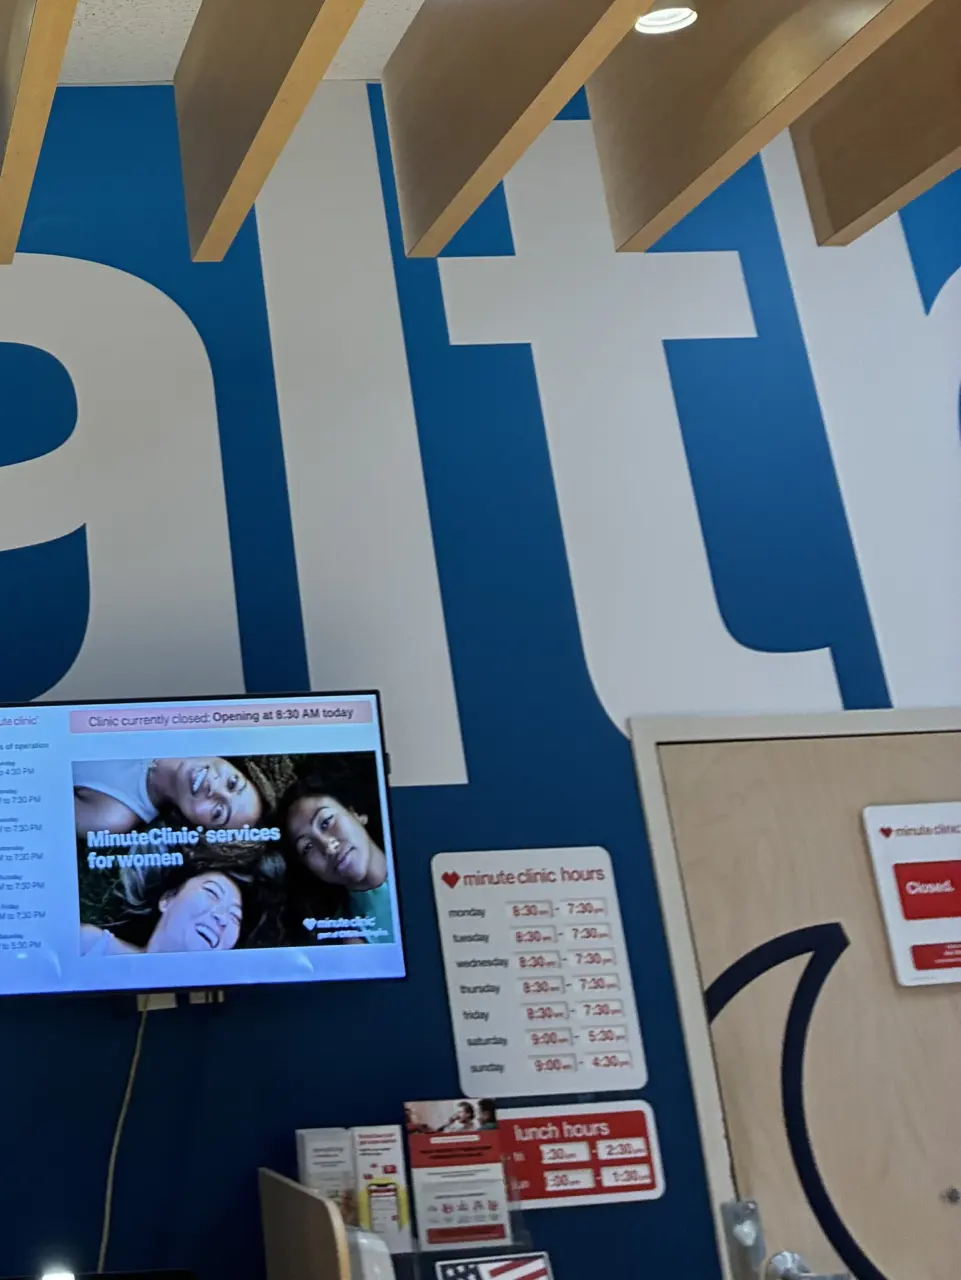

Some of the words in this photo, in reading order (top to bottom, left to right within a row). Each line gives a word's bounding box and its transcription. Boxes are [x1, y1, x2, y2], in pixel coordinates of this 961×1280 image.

[89, 716, 116, 727] Clinic
[121, 713, 169, 726] currently
[171, 712, 210, 724] closed:
[212, 710, 260, 724] Opening
[262, 710, 273, 720] at
[276, 709, 300, 720] 8:30
[302, 708, 320, 718] AM
[322, 706, 354, 720] today
[5, 741, 13, 750] of
[15, 742, 50, 751] operation
[206, 824, 281, 843] services
[895, 825, 933, 836] minute
[87, 851, 113, 869] for
[117, 850, 183, 868] women
[463, 870, 515, 886] minute
[517, 868, 557, 884] clinic
[560, 866, 605, 882] hours
[448, 907, 486, 918] monday
[452, 933, 489, 943] tuesday
[456, 957, 509, 968] wednesday
[459, 984, 500, 995] thursday
[462, 1010, 489, 1021] friday
[470, 1063, 504, 1074] sunday
[513, 1122, 558, 1141] lunch
[561, 1121, 610, 1138] hours
